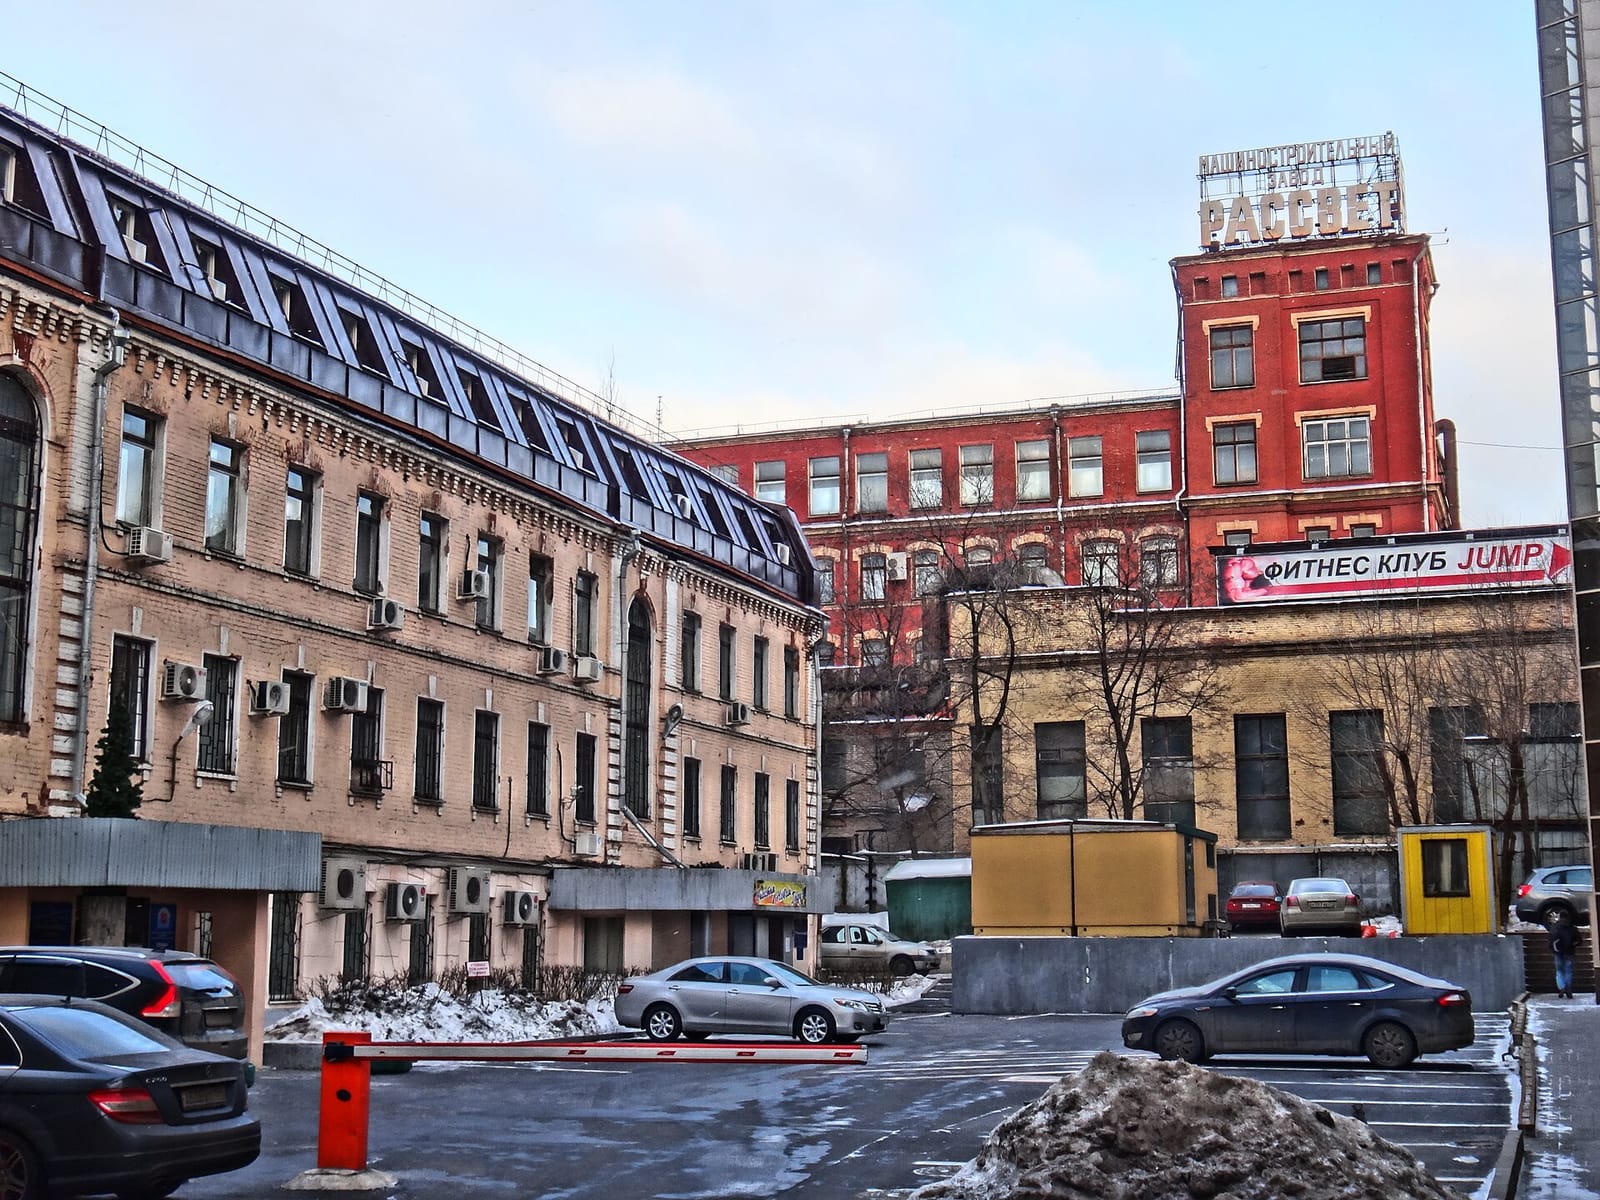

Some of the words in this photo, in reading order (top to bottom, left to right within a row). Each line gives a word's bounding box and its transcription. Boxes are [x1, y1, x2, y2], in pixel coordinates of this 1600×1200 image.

[1199, 130, 1395, 175] МАШИНОСТРОИТЕЛЬНЫЙ
[1267, 167, 1324, 190] ЗАВОД
[1200, 181, 1399, 247] РАССВЕТ
[1264, 554, 1370, 581] ФИТНЕС
[1377, 551, 1447, 574] КЛУБ
[1457, 543, 1543, 570] JUMP
